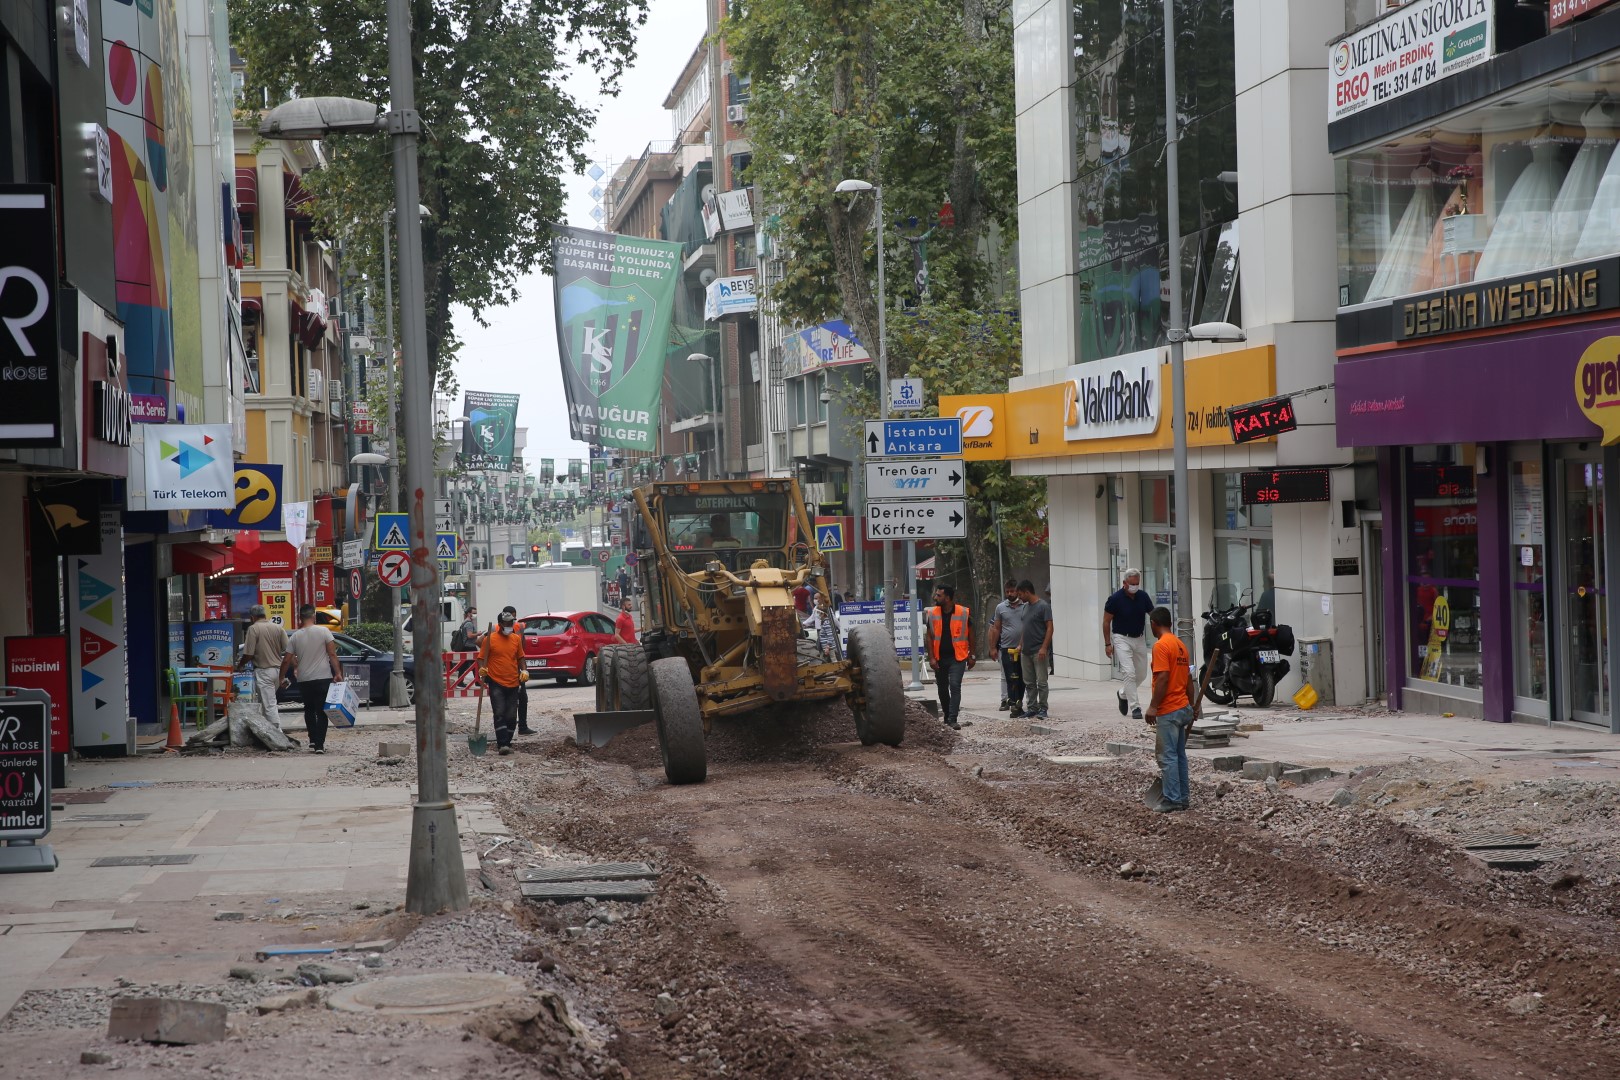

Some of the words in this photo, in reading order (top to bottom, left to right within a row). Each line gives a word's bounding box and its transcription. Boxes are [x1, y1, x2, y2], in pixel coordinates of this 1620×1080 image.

[1552, 1, 1567, 20] 331
[1350, 12, 1420, 70] METİNCAN
[1421, 0, 1486, 39] SİGORTA
[1457, 33, 1484, 50] Groupama
[1373, 59, 1397, 80] Metin
[1399, 41, 1434, 68] ERDİNÇ
[1336, 71, 1370, 107] ERGO
[1372, 82, 1392, 102] TEL:
[1393, 72, 1409, 95] 331
[1412, 65, 1423, 86] 47
[1425, 60, 1437, 82] 84
[555, 235, 675, 259] KOCAELİSPORUMUZ'A
[558, 246, 594, 259] SÜPER
[597, 251, 616, 262] LİG
[619, 255, 671, 270] YOLUNDA
[563, 258, 624, 274] BAŞARILAR
[627, 267, 663, 279] DİLER.
[1404, 290, 1478, 336] DESİNA
[1486, 267, 1599, 321] WEDDİNG
[3, 366, 48, 380] ROSE
[1081, 366, 1153, 425] VakıfBank
[102, 380, 132, 447] TUDORS
[130, 400, 145, 415] knik
[146, 402, 166, 417] Servis
[598, 404, 649, 424] UĞUR
[600, 423, 647, 441] ÜLGER
[888, 424, 952, 437] İstanbul
[888, 442, 942, 453] Ankara
[962, 440, 993, 449] kıfBank
[878, 466, 907, 477] Tren
[911, 465, 937, 475] Garı
[1272, 472, 1279, 484] F
[897, 477, 930, 488] YHT
[153, 489, 177, 499] Türk
[181, 489, 227, 499] Telekom
[1257, 485, 1280, 500] SİG
[695, 496, 756, 508] CATERPILLAR
[871, 507, 935, 519] Derince
[873, 523, 926, 535] Körfez
[319, 568, 329, 587] Pide
[1435, 605, 1447, 626] 40
[11, 661, 60, 673] İNDİRİMİ
[13, 741, 39, 750] ROSE
[1, 797, 34, 807] varan
